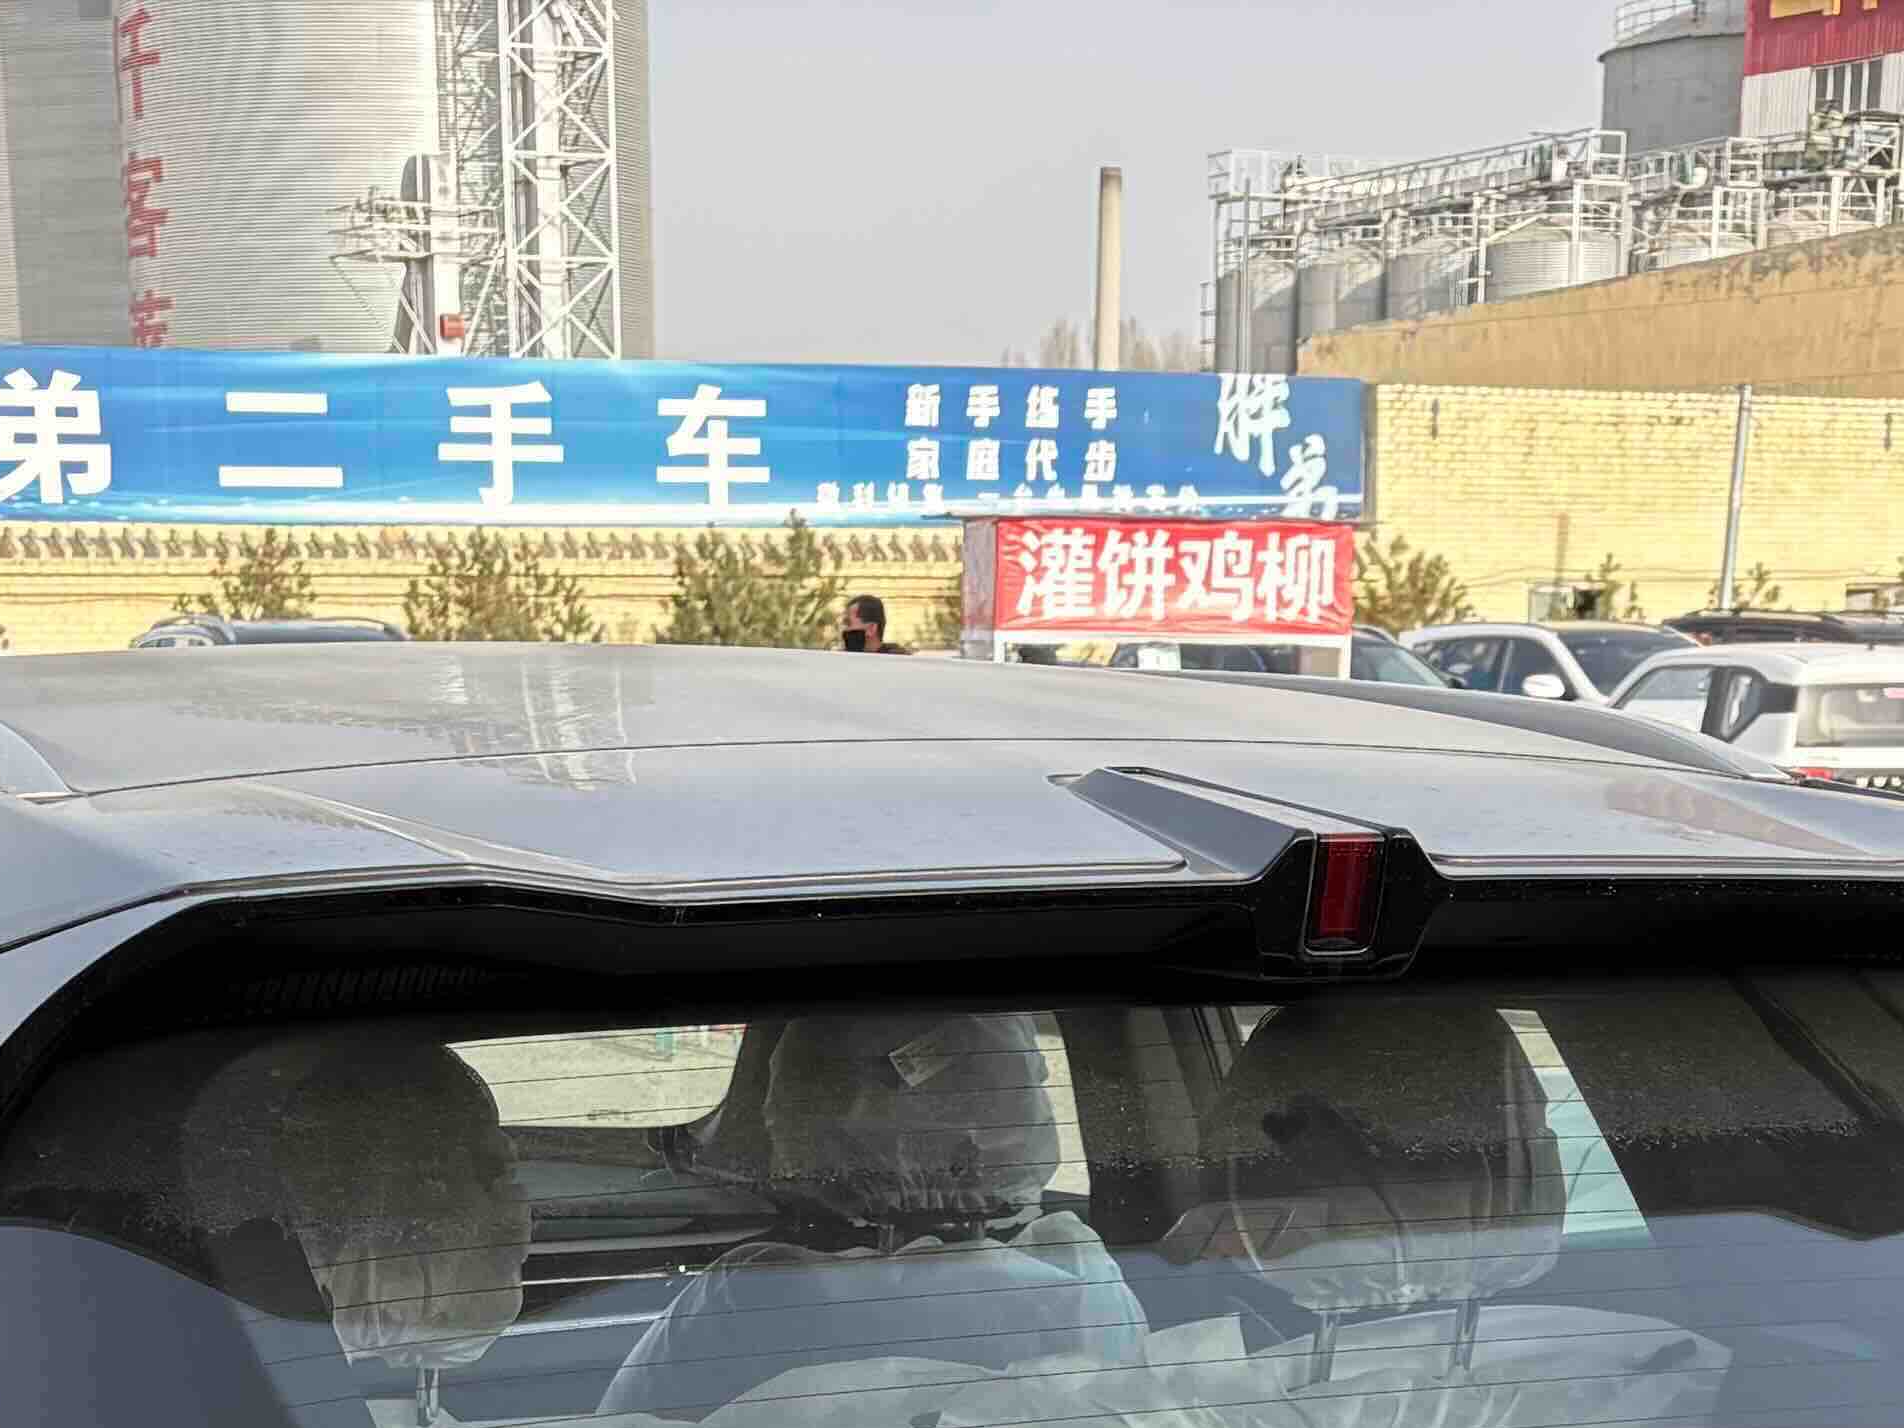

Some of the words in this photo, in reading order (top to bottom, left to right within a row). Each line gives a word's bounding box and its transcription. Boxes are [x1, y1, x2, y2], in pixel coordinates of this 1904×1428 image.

[906, 438, 1117, 481] 家庭代步
[1016, 527, 1336, 624] 灌饼鸡柳
